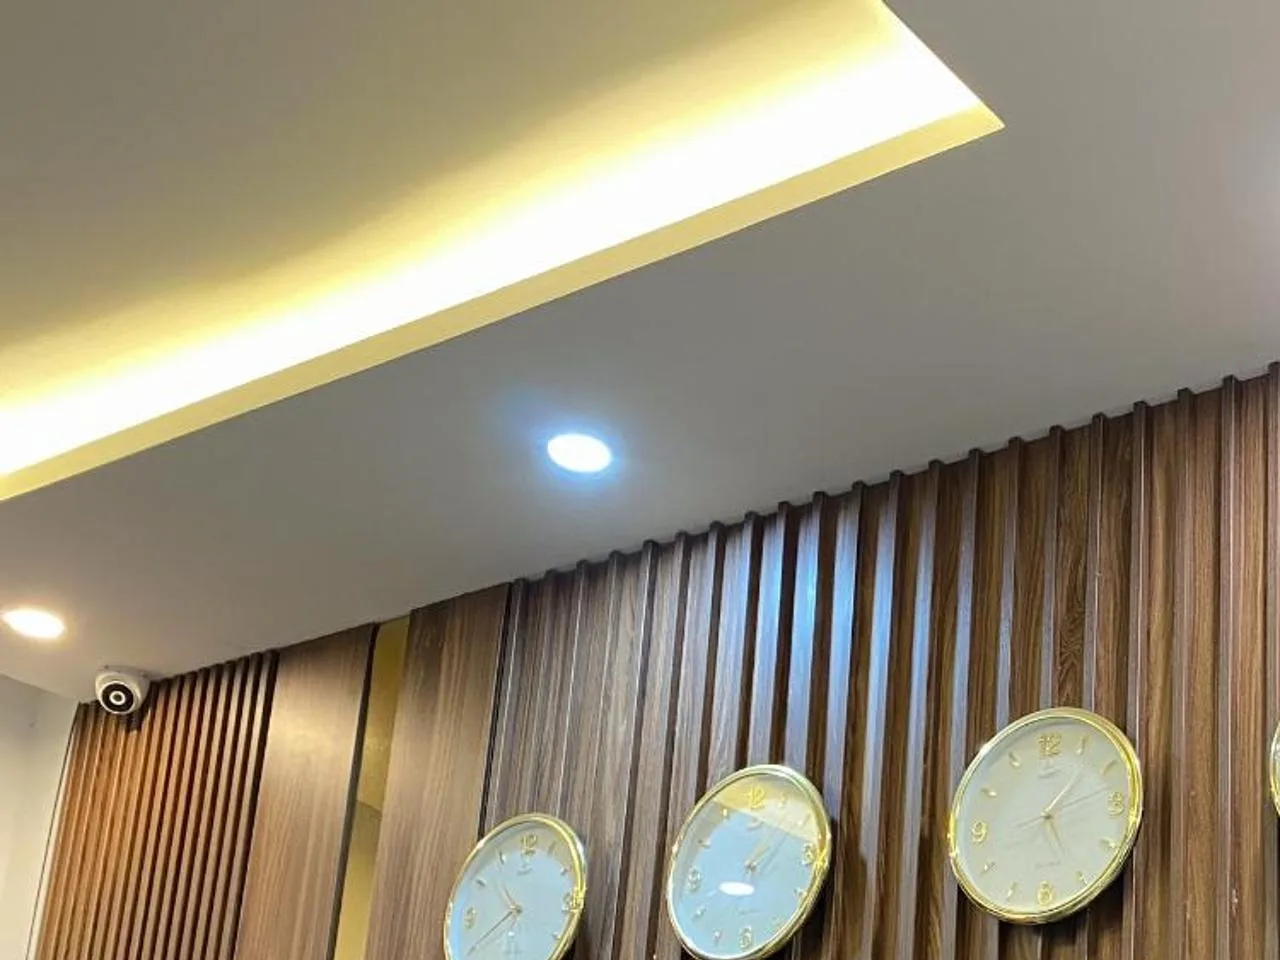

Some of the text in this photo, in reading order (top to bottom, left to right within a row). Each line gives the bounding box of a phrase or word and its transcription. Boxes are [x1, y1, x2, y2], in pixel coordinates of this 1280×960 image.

[1039, 734, 1061, 757] 12
[1109, 791, 1124, 816] 3
[972, 820, 988, 842] 9
[1037, 880, 1052, 906] 6
